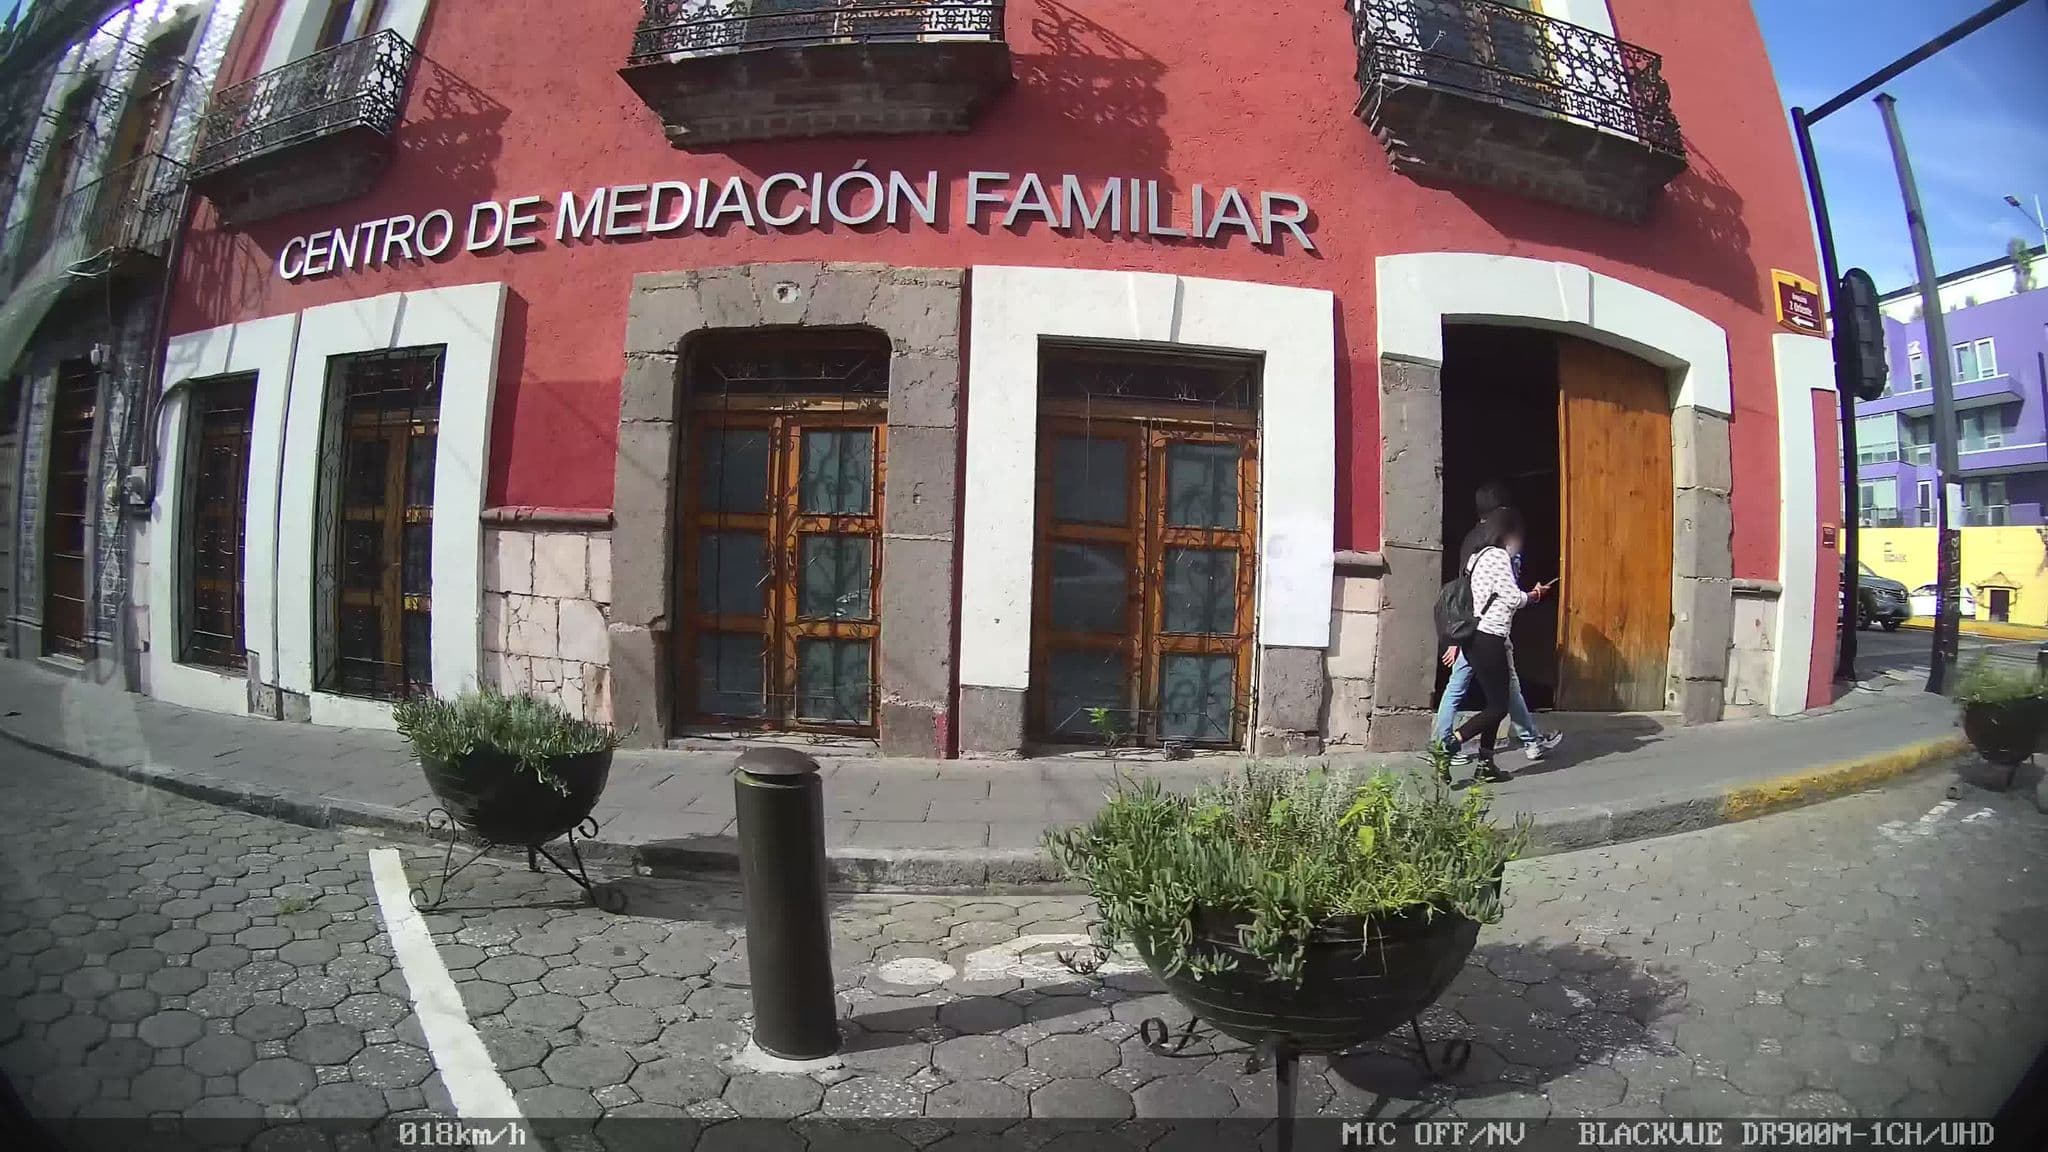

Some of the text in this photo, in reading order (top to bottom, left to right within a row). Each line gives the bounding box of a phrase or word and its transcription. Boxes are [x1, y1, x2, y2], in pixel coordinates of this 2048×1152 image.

[279, 159, 1315, 280] CENTRO DE MEDIACIÓN FAMILIAR
